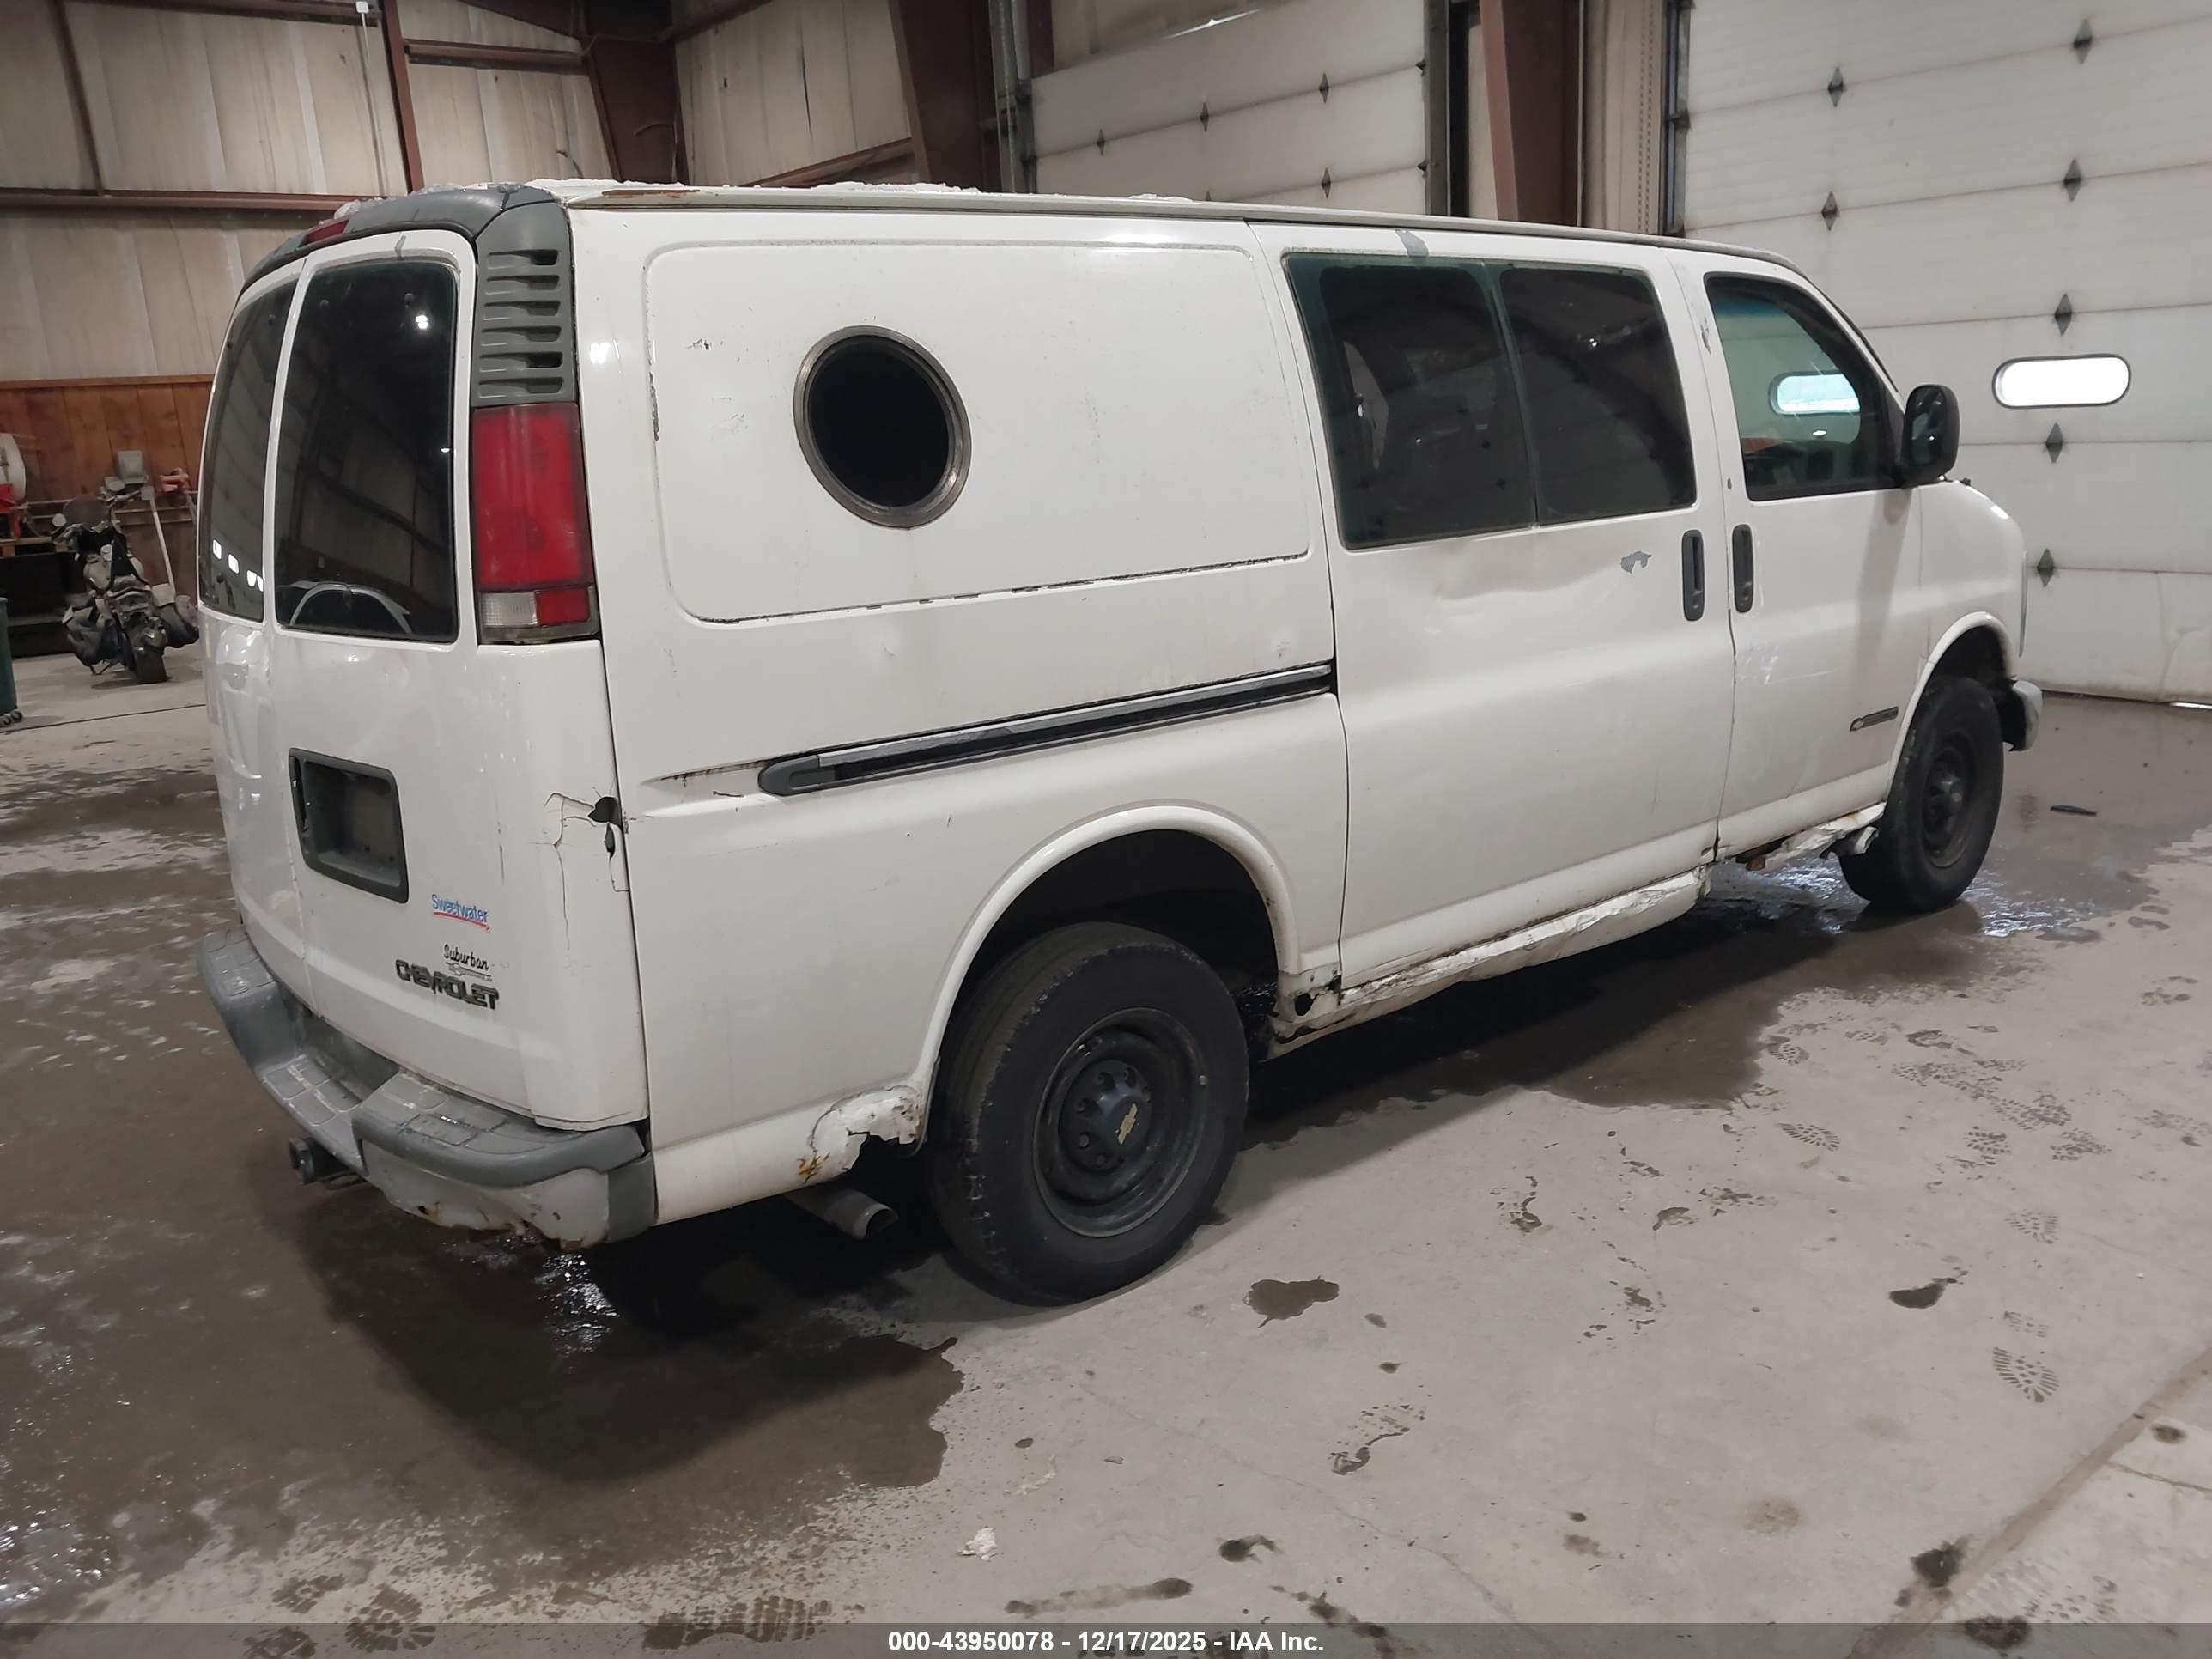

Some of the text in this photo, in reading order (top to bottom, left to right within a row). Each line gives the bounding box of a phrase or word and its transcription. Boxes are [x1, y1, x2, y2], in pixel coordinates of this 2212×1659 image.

[431, 894, 488, 922] Sweetwater
[444, 943, 489, 970] Suburban
[396, 959, 499, 1010] CHEVROLET
